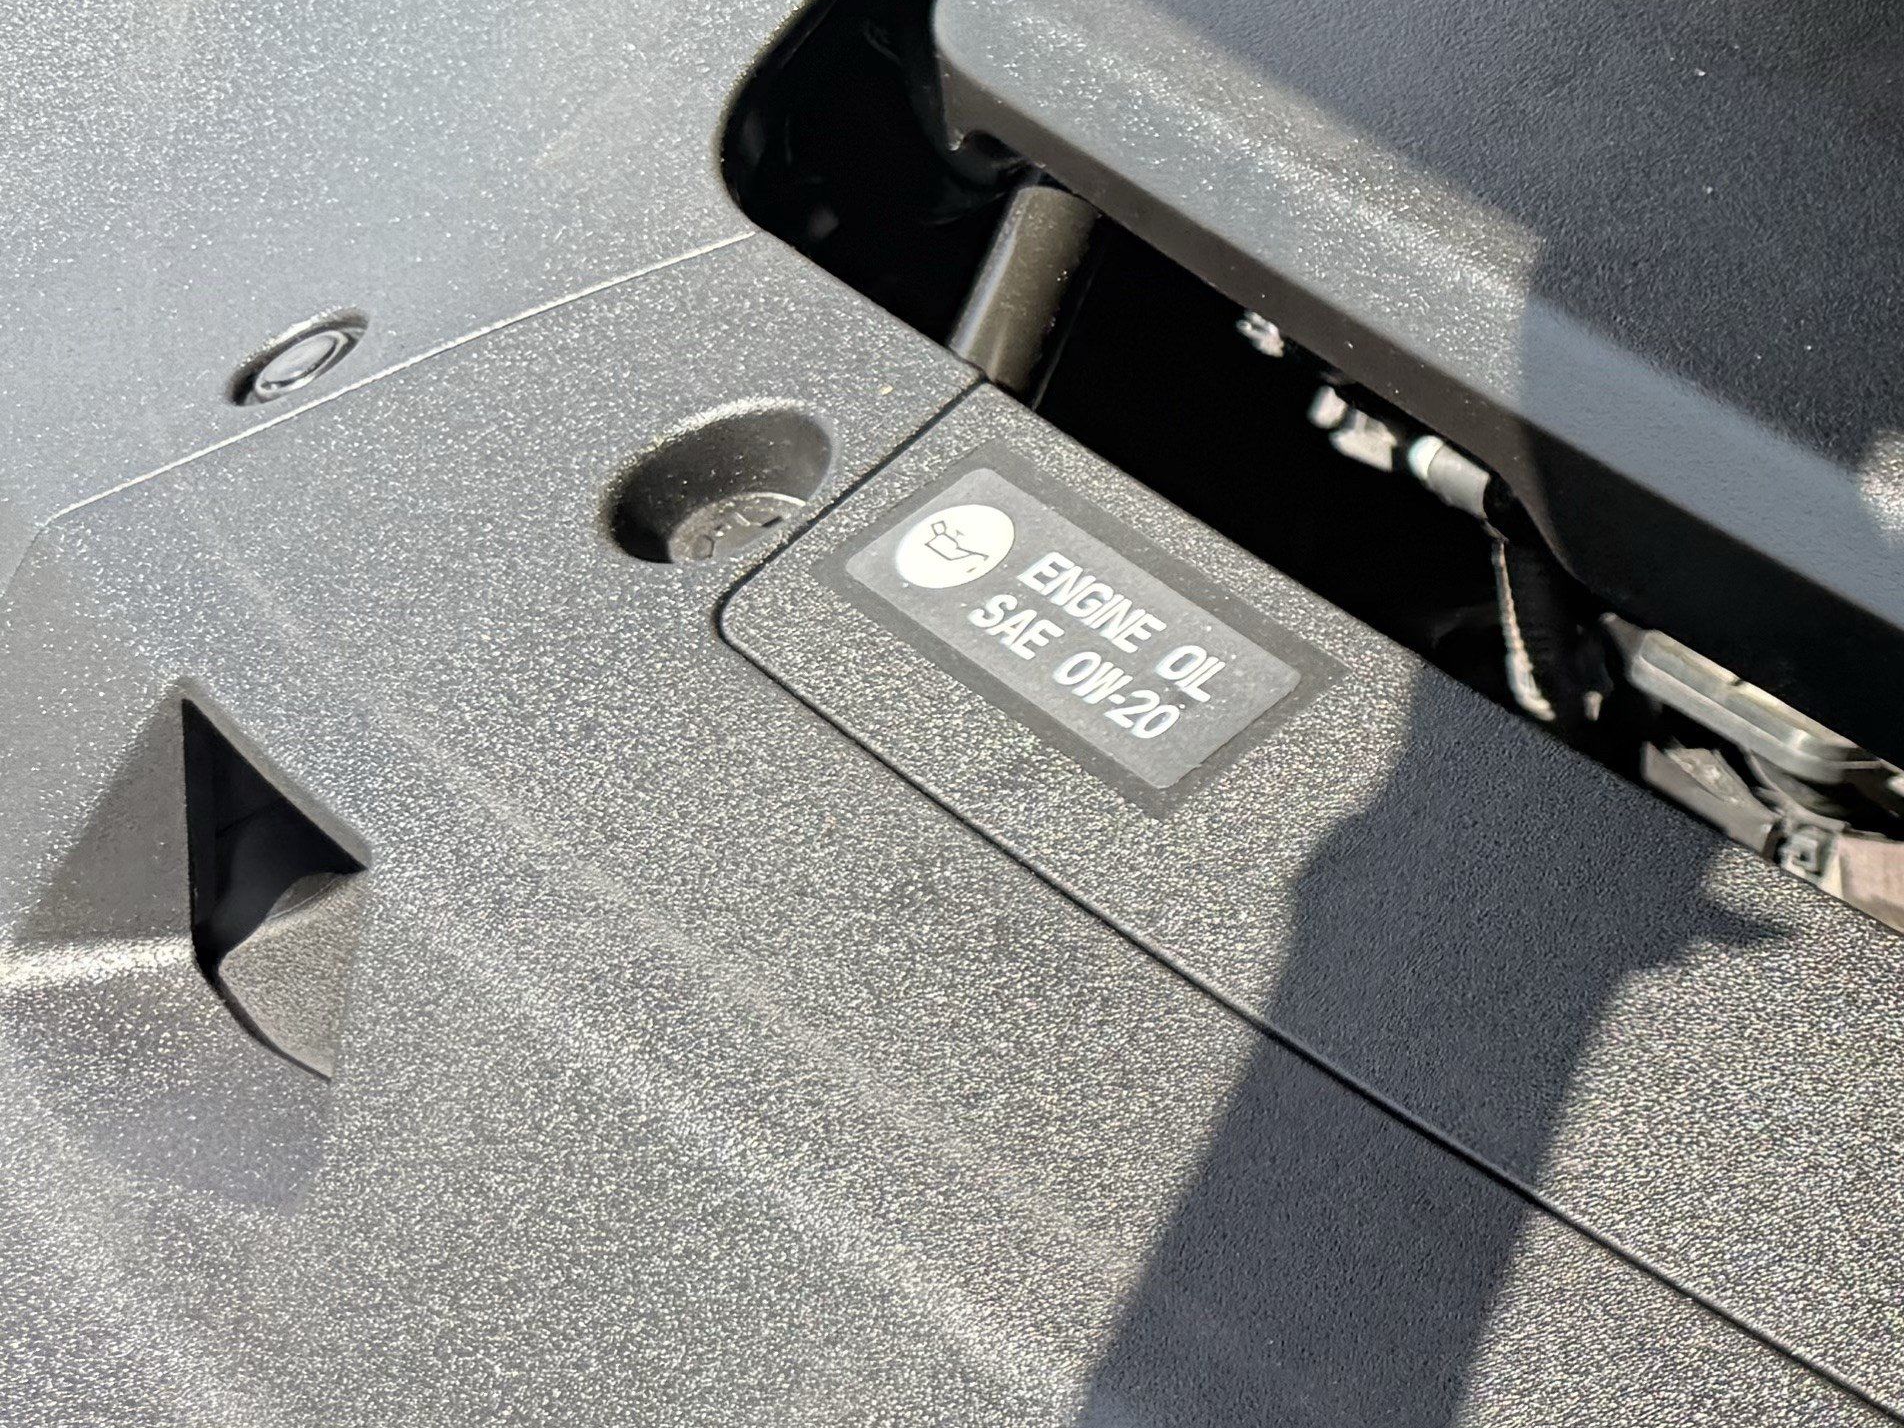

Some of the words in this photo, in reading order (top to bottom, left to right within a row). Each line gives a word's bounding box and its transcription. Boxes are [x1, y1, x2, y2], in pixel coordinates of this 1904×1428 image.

[967, 592, 1065, 661] SAE
[1052, 650, 1182, 740] 0W-20
[1016, 550, 1167, 654] ENGINE
[1155, 643, 1226, 703] OIL
